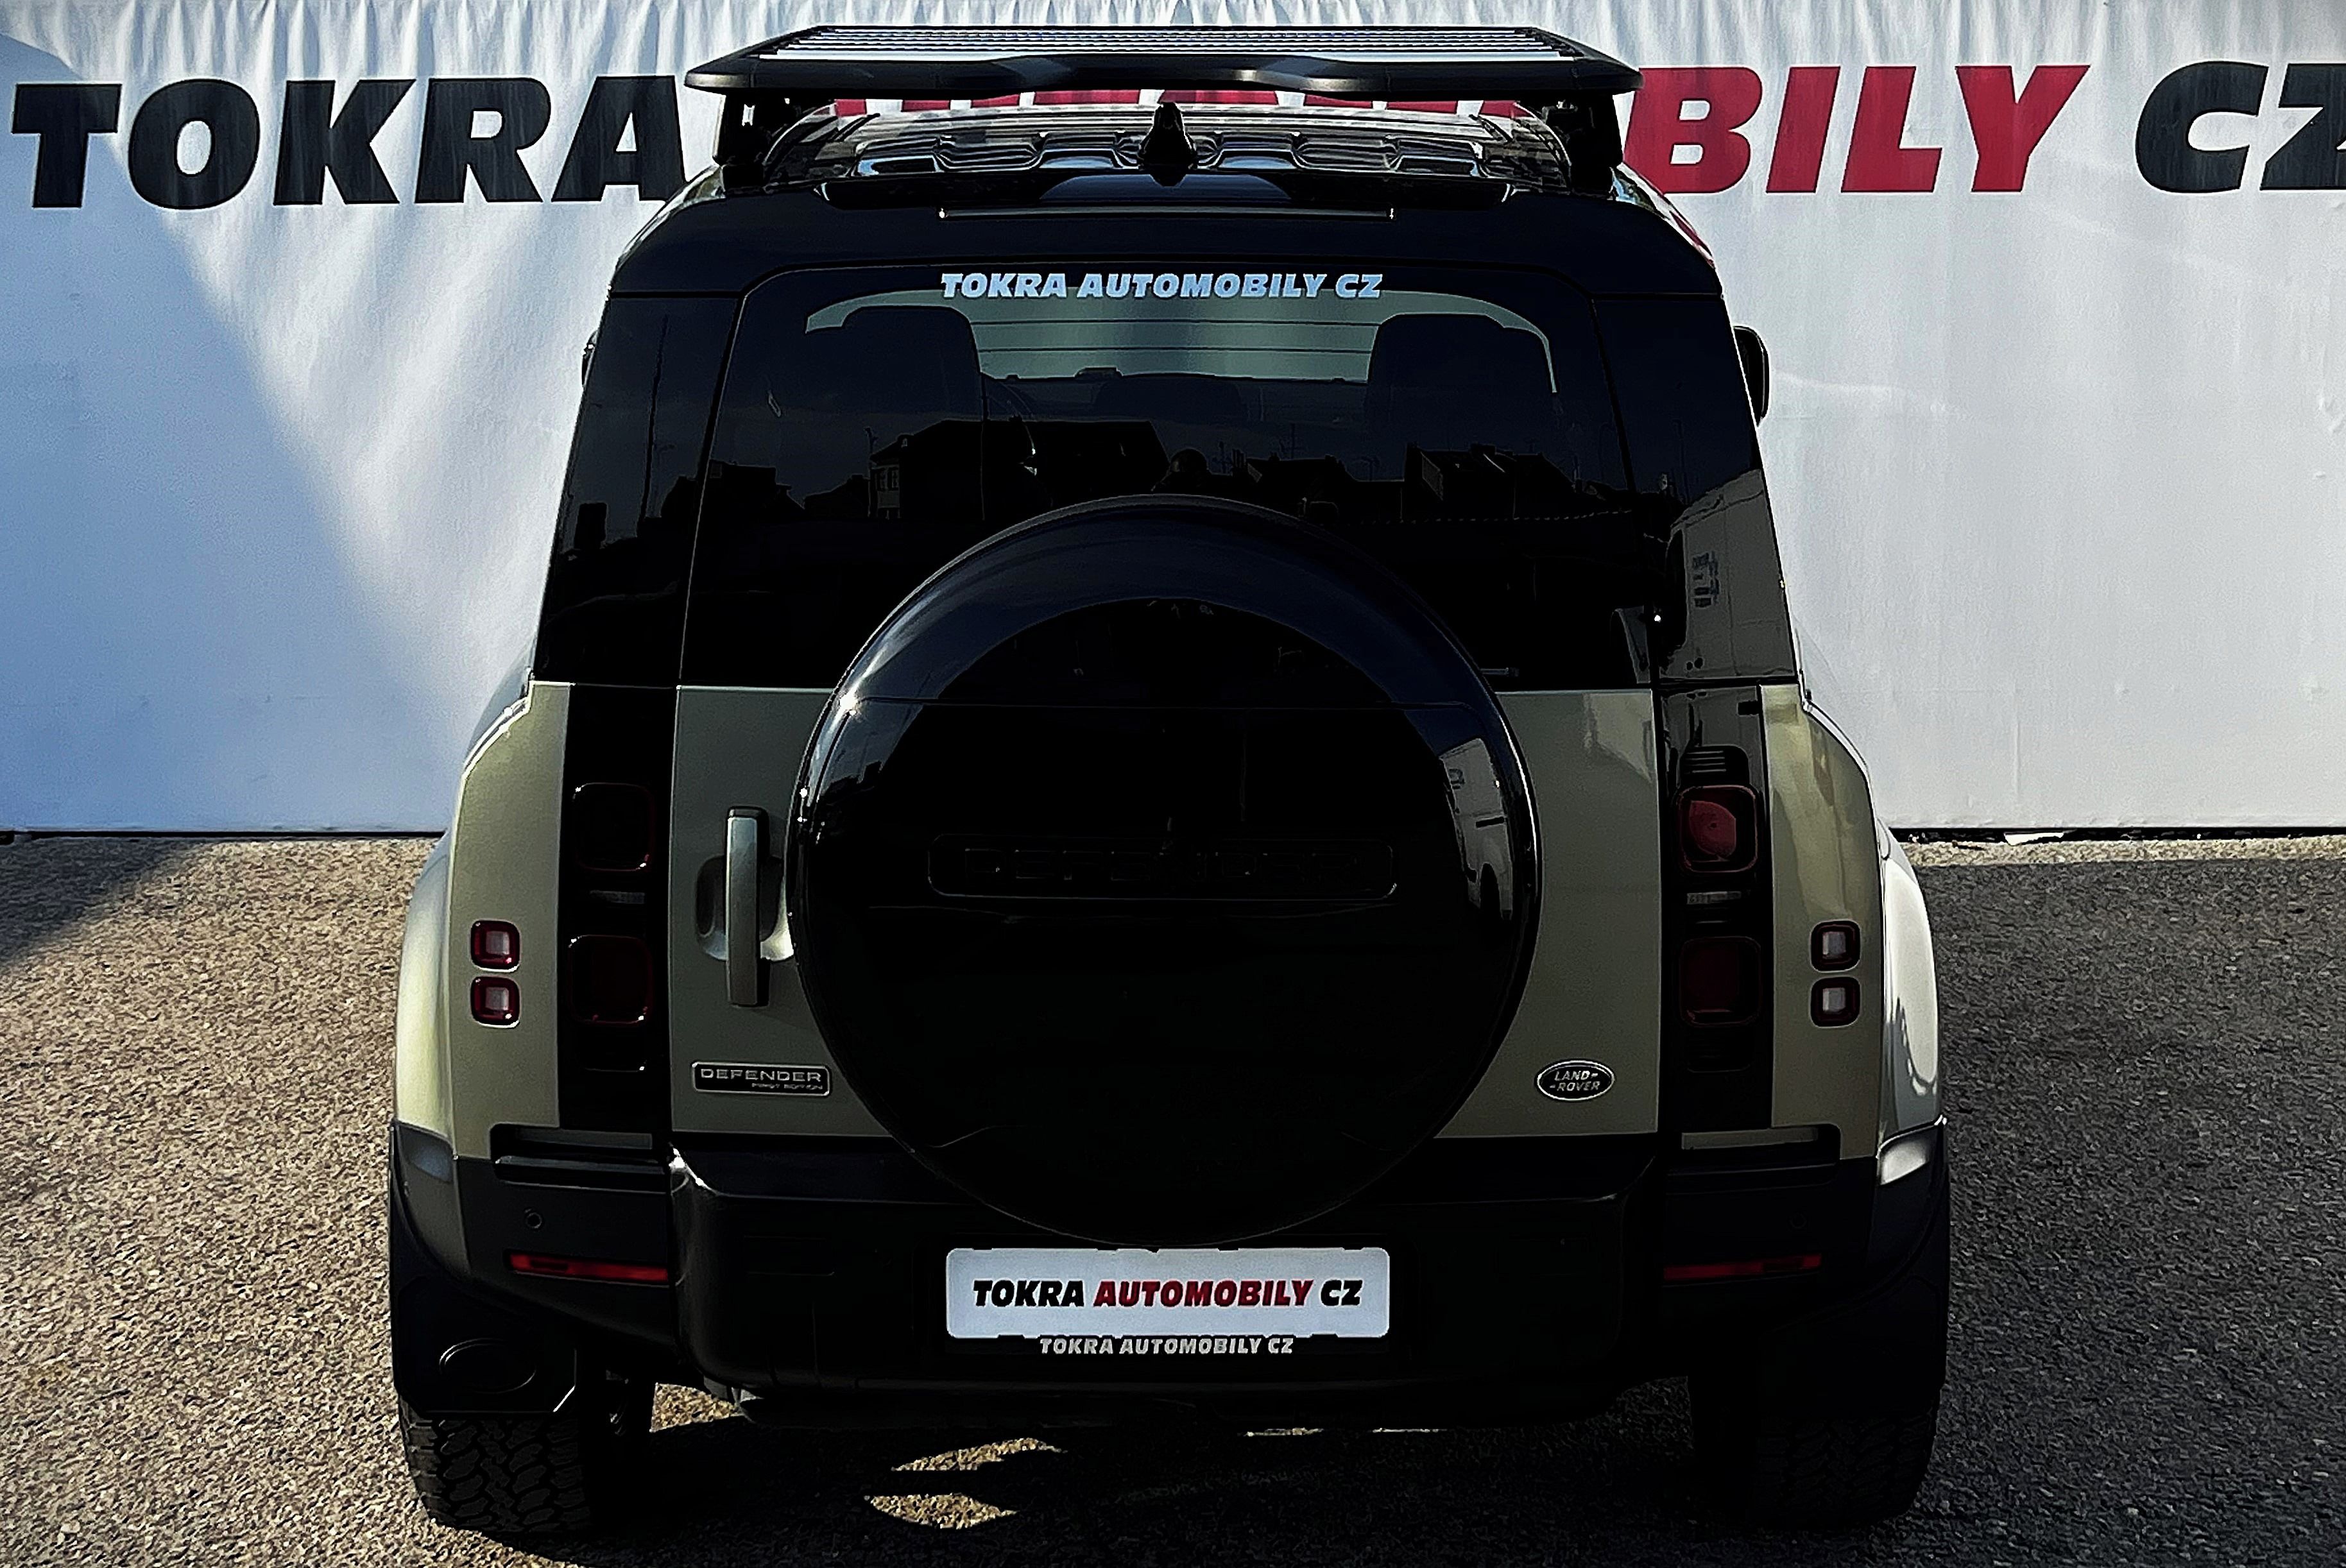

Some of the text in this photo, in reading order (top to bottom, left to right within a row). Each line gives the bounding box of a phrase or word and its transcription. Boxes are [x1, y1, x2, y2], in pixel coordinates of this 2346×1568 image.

[12, 76, 687, 209] TOKRA
[2135, 60, 2346, 194] CZ
[941, 273, 1383, 299] TOKRA AUTOMOBILY CZ
[701, 1068, 822, 1082] DEFENDER
[1554, 1070, 1598, 1081] LAND-
[1550, 1081, 1600, 1091] -ROVER
[973, 1280, 1363, 1307] TOKRA AUTOMOBILY CZ
[1040, 1338, 1294, 1354] TOKRA AUTOMOBILY CZ
